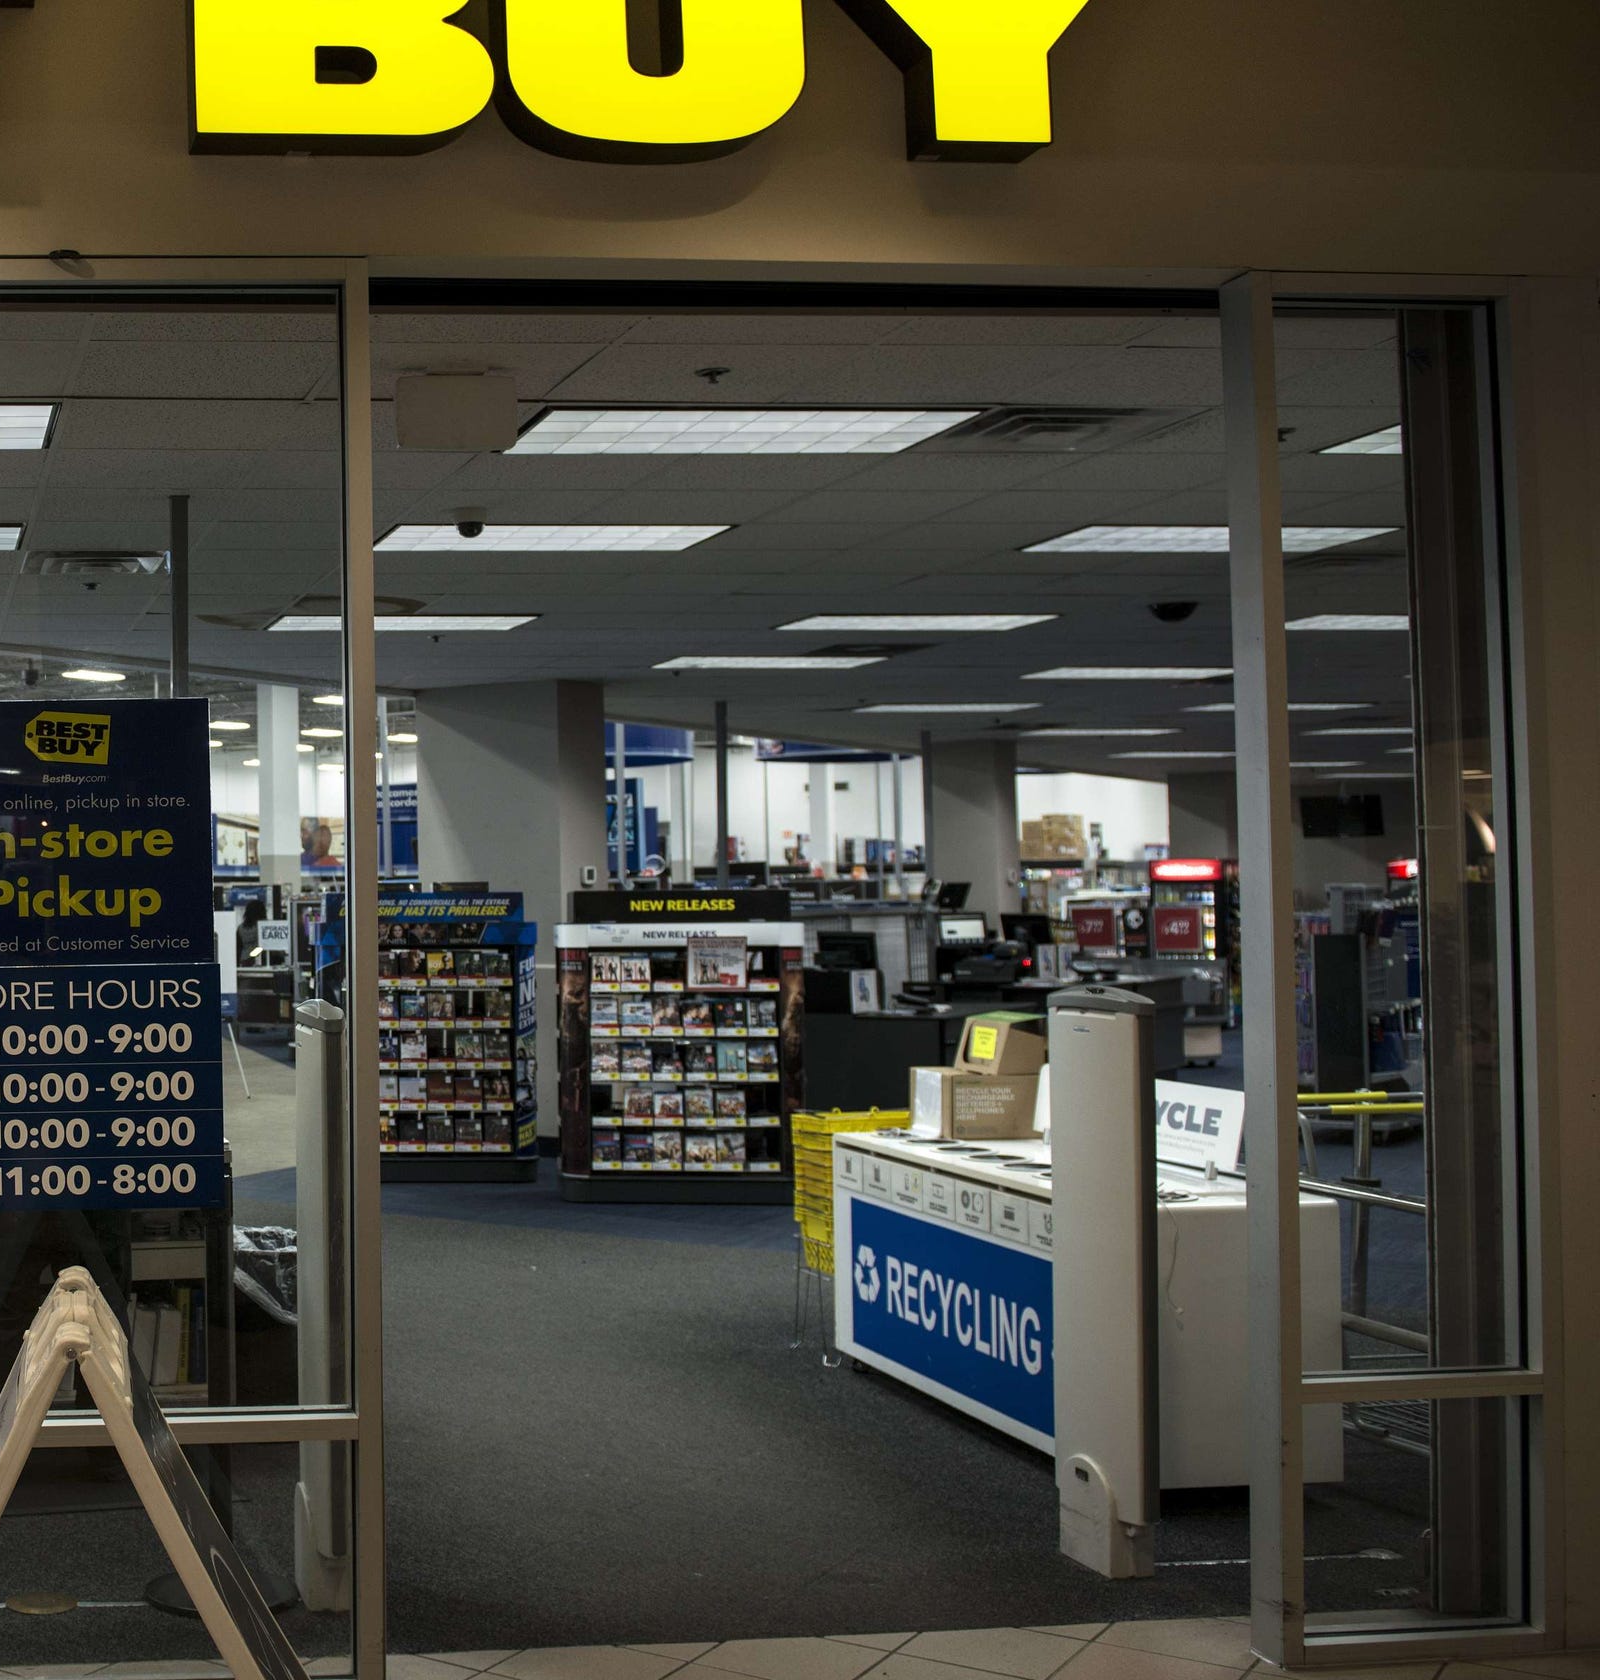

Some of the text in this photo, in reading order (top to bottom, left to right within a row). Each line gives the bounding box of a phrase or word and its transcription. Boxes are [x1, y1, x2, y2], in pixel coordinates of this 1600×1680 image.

[193, 0, 1090, 146] BUY
[35, 720, 108, 756] BEST BUY
[42, 773, 107, 785] BestBuy.com
[3, 793, 58, 812] online,
[65, 794, 120, 813] pickup
[126, 794, 140, 808] in
[147, 795, 191, 808] store.
[403, 906, 427, 917] HAS
[427, 906, 446, 916] ITS
[630, 899, 736, 912] NEW RELEASES
[25, 937, 41, 951] at
[46, 935, 123, 951] Customer
[130, 934, 190, 950] Service
[642, 929, 718, 939] NEW RELEASES
[68, 977, 202, 1010] HOURS
[886, 1254, 1042, 1376] RECYCLING
